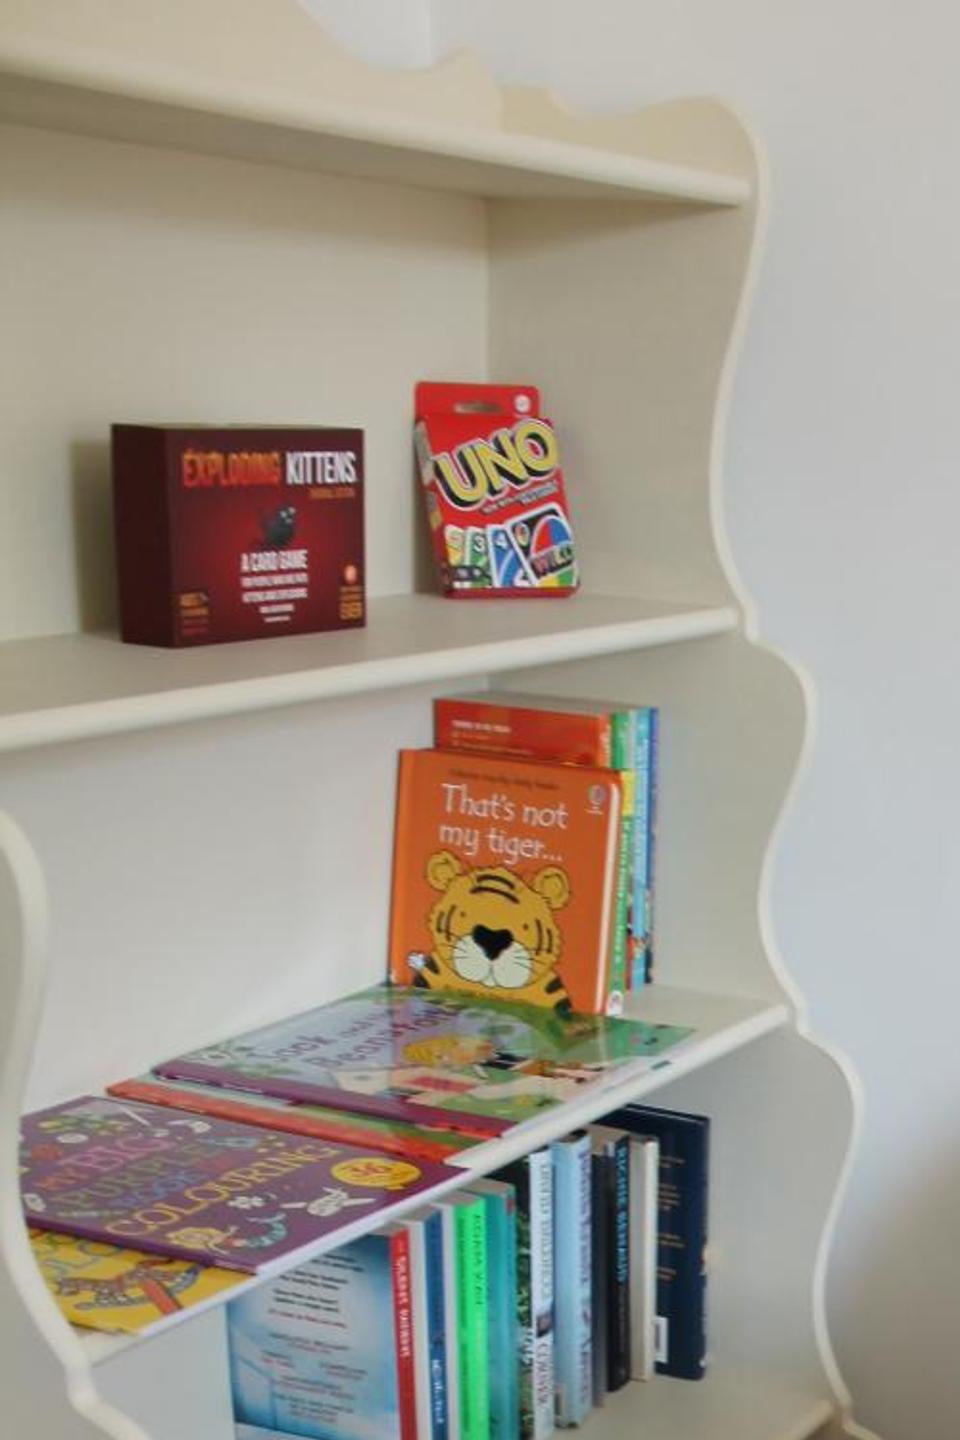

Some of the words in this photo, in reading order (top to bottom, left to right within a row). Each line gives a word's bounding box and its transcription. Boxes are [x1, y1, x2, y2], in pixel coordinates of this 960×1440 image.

[286, 451, 357, 485] KITTENS
[433, 419, 559, 508] UNO
[474, 536, 485, 552] 3
[441, 783, 515, 825] That's
[522, 803, 568, 829] not
[439, 823, 477, 857] my
[104, 1143, 341, 1237] COLOURING
